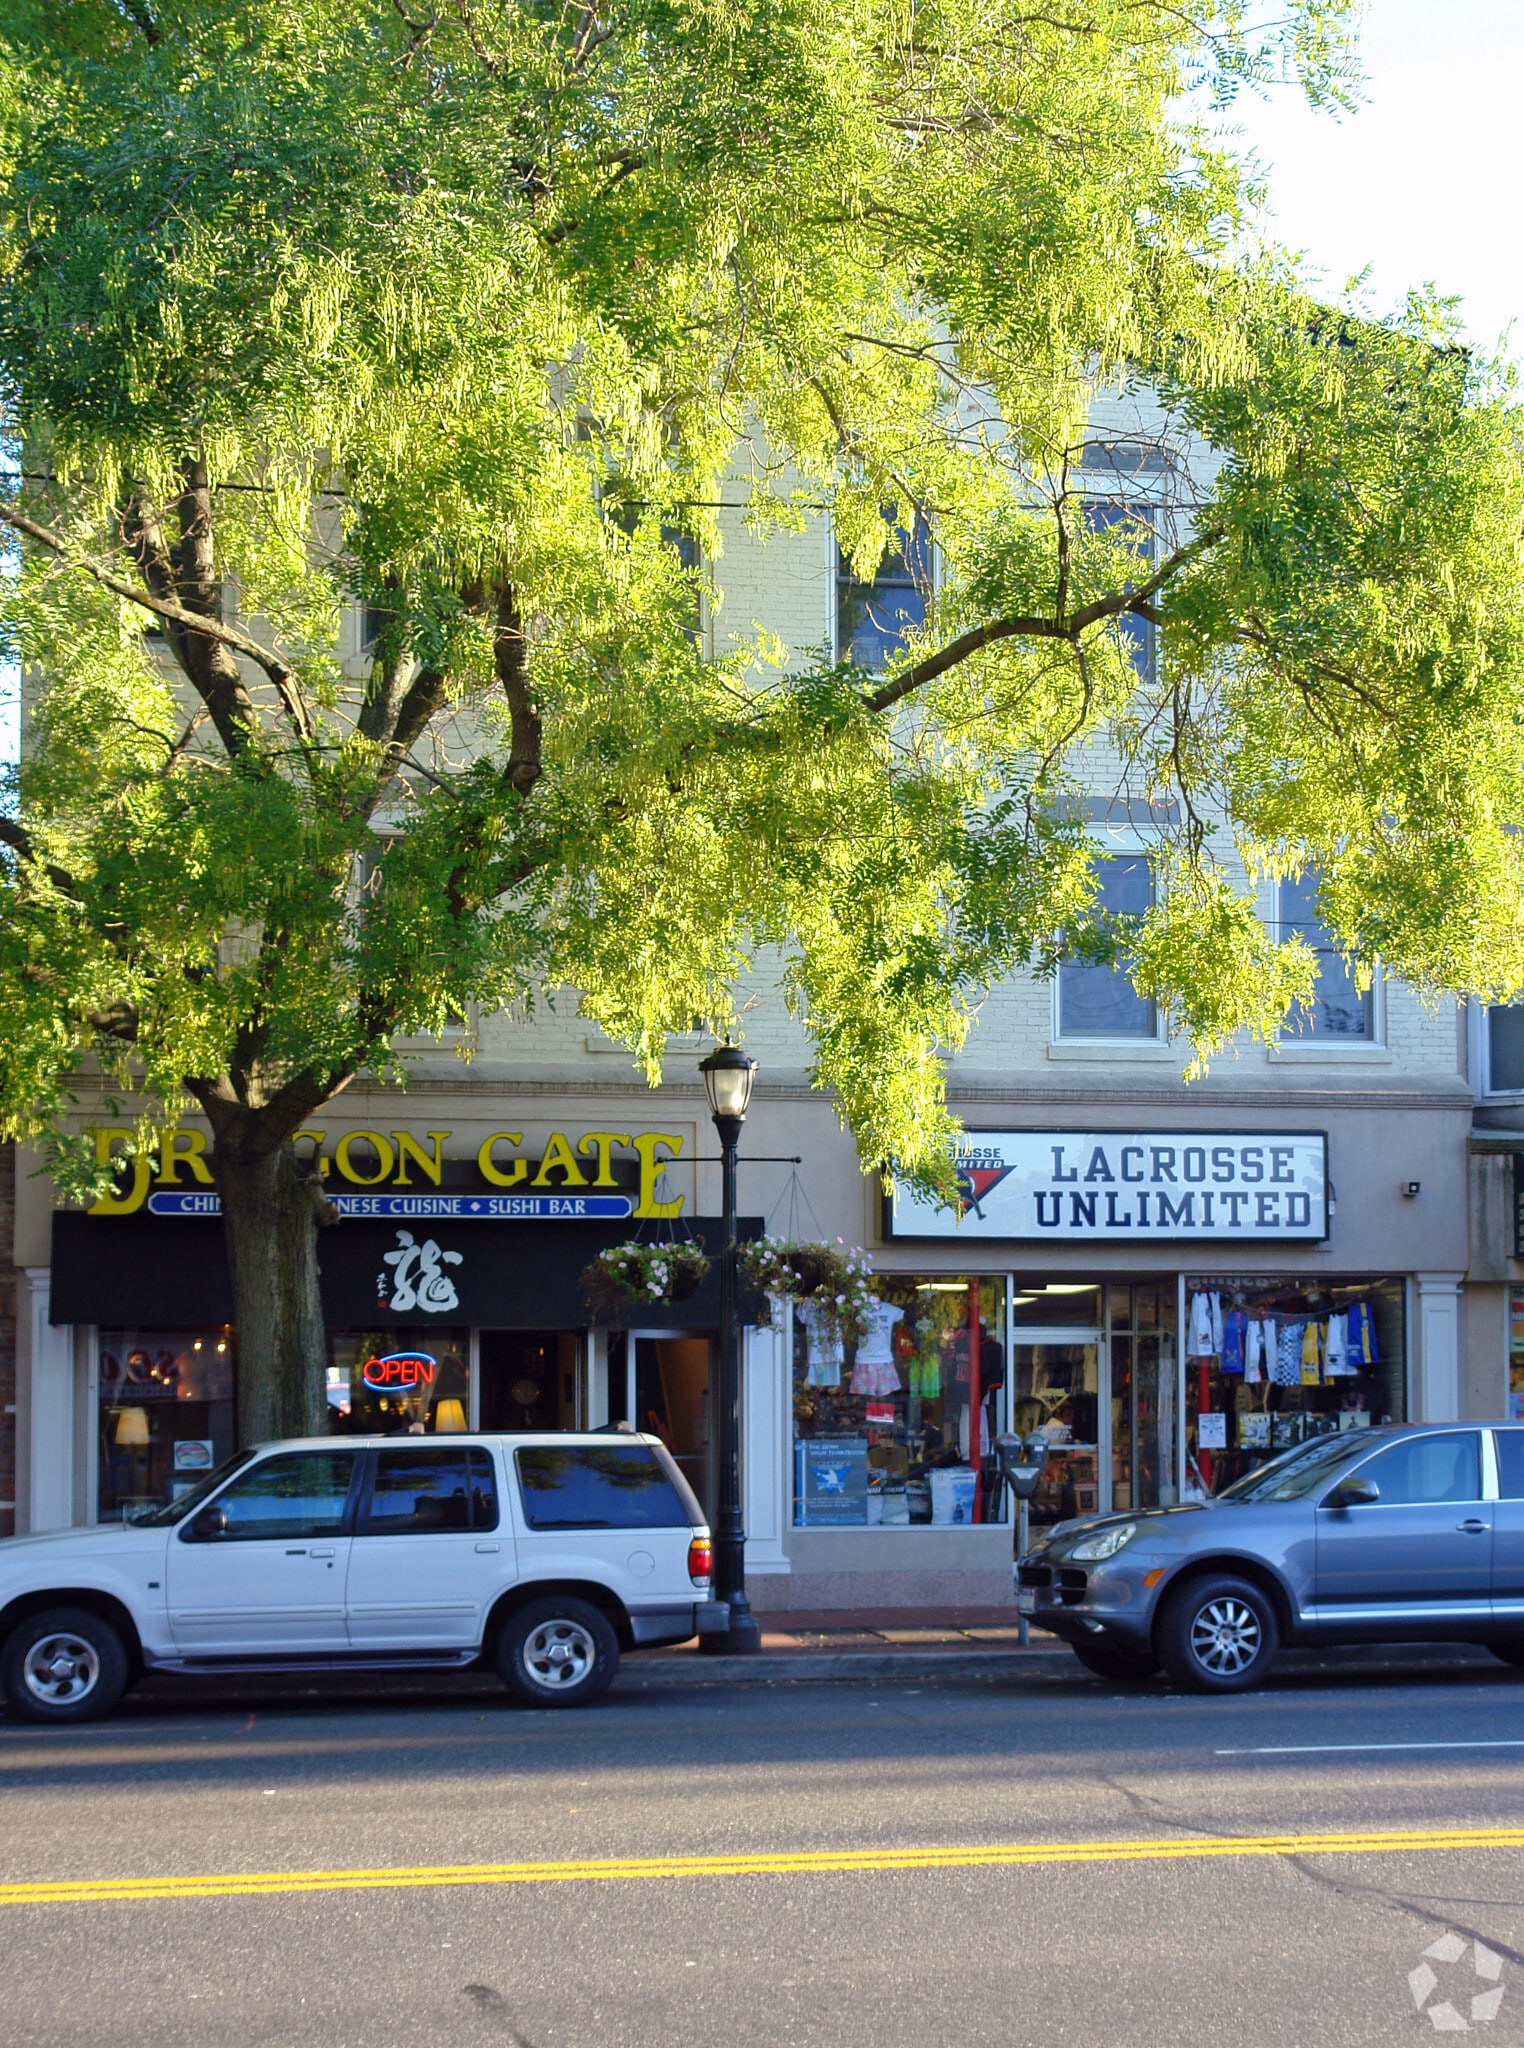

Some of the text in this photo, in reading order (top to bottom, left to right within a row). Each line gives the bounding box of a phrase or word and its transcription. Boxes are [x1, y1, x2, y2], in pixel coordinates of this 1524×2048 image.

[478, 1131, 685, 1219] GATE
[1050, 1146, 1295, 1183] LACROSSE
[389, 1199, 461, 1214] CUISINE
[489, 1199, 540, 1214] SUSHI
[550, 1199, 586, 1214] BAR
[1033, 1191, 1311, 1227] UNLIMITED
[363, 1359, 435, 1383] OPEN
